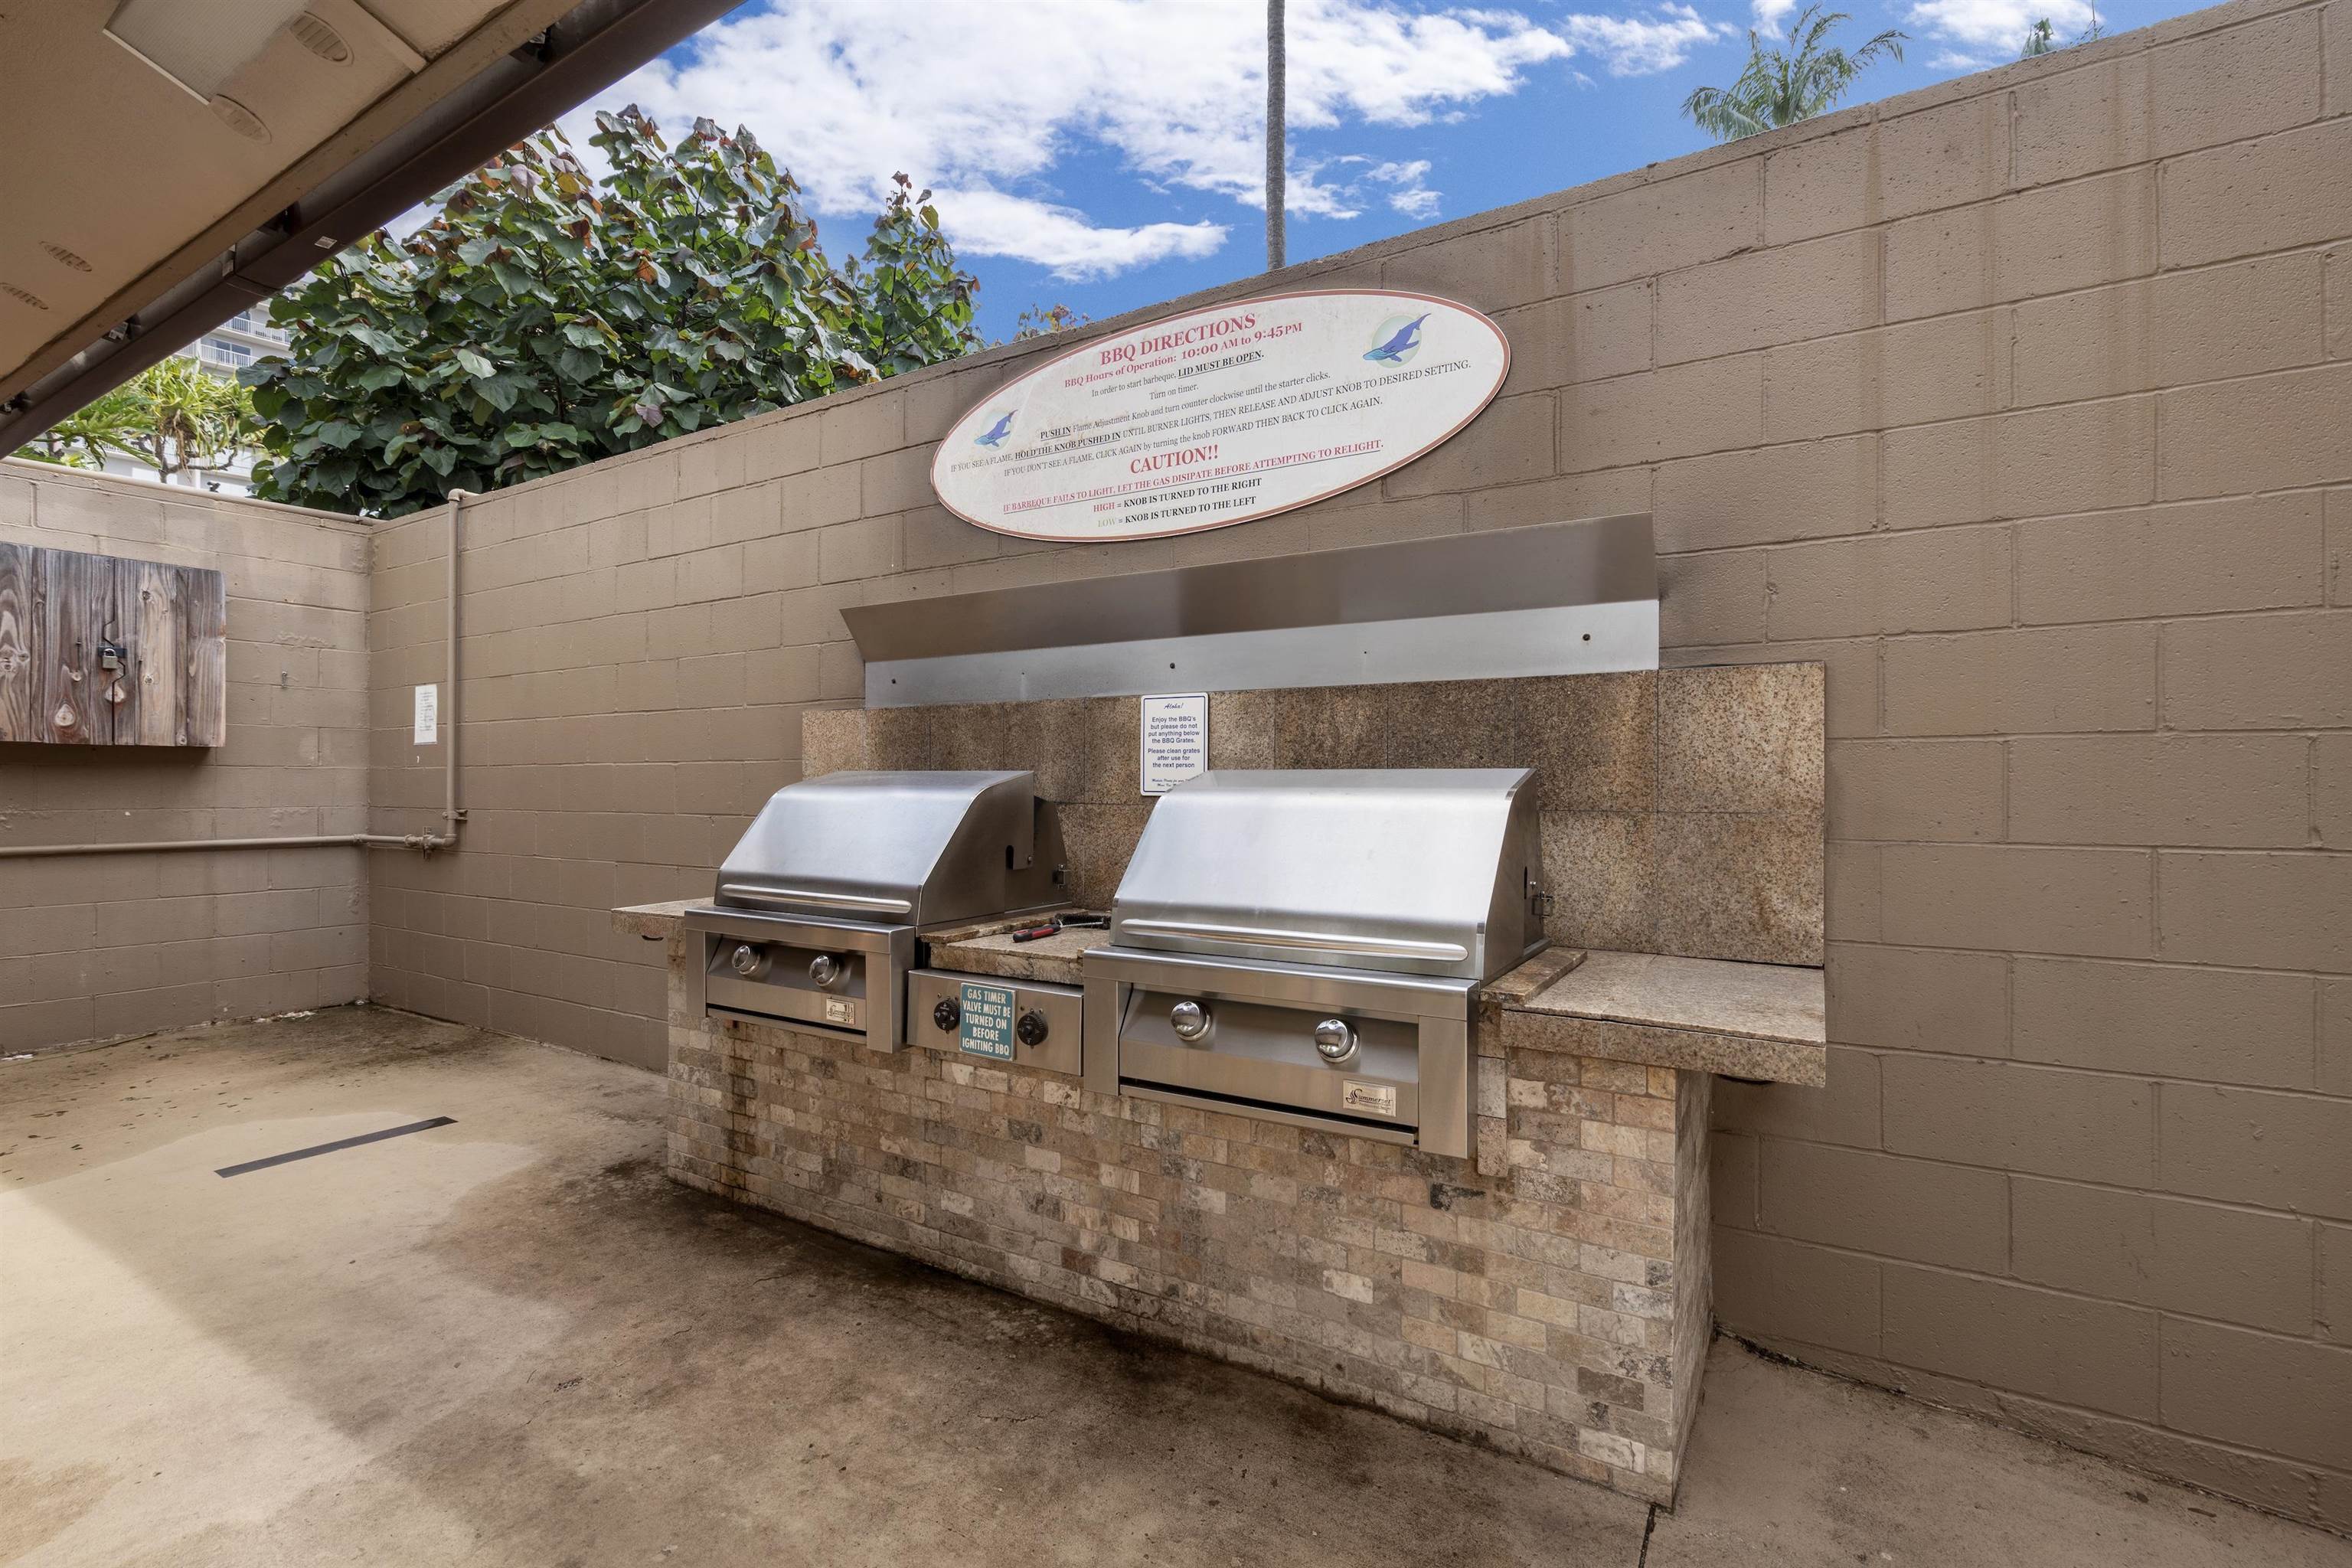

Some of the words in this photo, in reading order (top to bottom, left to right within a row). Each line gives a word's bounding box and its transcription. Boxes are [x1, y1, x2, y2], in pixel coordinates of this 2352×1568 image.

[1100, 345, 1136, 365] BBQ
[1139, 312, 1256, 355] DIRECTIONS
[1065, 376, 1083, 387] BBQ
[1086, 370, 1113, 382] Hours
[1116, 367, 1125, 375] of
[1126, 355, 1177, 373] Operation:
[1182, 343, 1218, 359] 10:00
[1221, 338, 1238, 349] AM
[1092, 389, 1099, 397] In
[1100, 384, 1118, 395] order
[1127, 380, 1142, 389] start
[1178, 367, 1194, 377] LID
[1195, 359, 1220, 374] MUST
[1223, 356, 1234, 367] BE
[1236, 350, 1265, 363] OPEN.
[1040, 428, 1063, 439] PUSH
[1063, 426, 1071, 435] IN
[1073, 423, 1093, 433] Flame
[1093, 414, 1130, 428] Adjustment
[1132, 410, 1149, 421] Knob
[1151, 407, 1164, 416] and
[1165, 403, 1180, 413] turn
[1181, 398, 1208, 410] counter
[1209, 391, 1244, 404] clockwise
[1246, 384, 1263, 397] until
[1265, 382, 1277, 392] the
[1279, 377, 1305, 389] starter
[1306, 371, 1331, 384] clicks.
[1149, 390, 1166, 400] Turn
[1178, 383, 1199, 394] timer.
[957, 462, 971, 471] YOU
[972, 459, 985, 468] SEE
[985, 458, 991, 466] A
[1014, 449, 1036, 460] HOLD
[1037, 445, 1054, 456] THE
[1054, 440, 1076, 452] KNOB
[1078, 433, 1110, 447] PUSHED
[1112, 431, 1121, 440] IN
[1122, 426, 1146, 438] UNTIL
[1147, 420, 1179, 433] BURNER
[1214, 407, 1236, 420] THEN
[1238, 400, 1276, 414] RELEASE
[1277, 394, 1297, 407] AND
[1298, 387, 1334, 402] ADJUST
[1335, 382, 1362, 395] KNOB
[1364, 379, 1377, 388] TO
[1379, 370, 1423, 386] DESIRED
[1424, 360, 1471, 377] SETTING.
[1011, 466, 1027, 475] YOU
[1048, 459, 1061, 468] SEE
[1096, 449, 1118, 460] CLICK
[1118, 443, 1142, 456] AGAIN
[1144, 443, 1151, 452] by
[1153, 438, 1178, 449] turning
[1180, 435, 1191, 443] the
[1192, 430, 1210, 441] knob
[1212, 422, 1254, 437] FORWARD
[1255, 416, 1280, 428] THEN
[1282, 411, 1305, 423] BACK
[1306, 408, 1319, 418] TO
[1321, 403, 1348, 416] CLICK
[1350, 397, 1383, 410] AGAIN.
[1011, 497, 1051, 510] BARBEQUE
[1053, 493, 1075, 503] FAILS
[1076, 491, 1087, 499] TO
[1117, 483, 1133, 492] LET
[1135, 480, 1151, 490] THE
[1153, 475, 1170, 486] GAS
[1172, 468, 1213, 483] DISIPATE
[1214, 462, 1252, 476] BEFORE
[1253, 451, 1316, 469] ATTEMPTING
[1318, 449, 1331, 458] TO
[1334, 439, 1383, 455] RELIGHT.
[1130, 444, 1219, 474] CAUTION!!
[1093, 502, 1115, 512] HIGH
[1124, 496, 1148, 508] KNOB
[1149, 494, 1158, 503] IS
[1158, 487, 1195, 502] TURNED
[1197, 486, 1209, 495] TO
[1210, 482, 1230, 494] THE
[1231, 478, 1262, 491] RIGHT
[1098, 517, 1116, 528] LOW
[1125, 512, 1149, 524] KNOB
[1151, 511, 1159, 520] IS
[1160, 505, 1197, 518] TURNED
[1198, 503, 1210, 512] TO
[1212, 499, 1231, 510] THE
[1233, 496, 1256, 507] LEFT
[962, 1000, 982, 1013] VALVE
[983, 1004, 1001, 1016] MUST
[1003, 1007, 1011, 1018] BE
[967, 988, 982, 999] GAS
[984, 991, 1006, 1004] TIMER
[965, 1013, 994, 1027] TURNED
[996, 1018, 1007, 1030] ON
[972, 1027, 999, 1041] BEFORE
[962, 1037, 993, 1053] IGNITING
[995, 1044, 1010, 1056] BBQ
